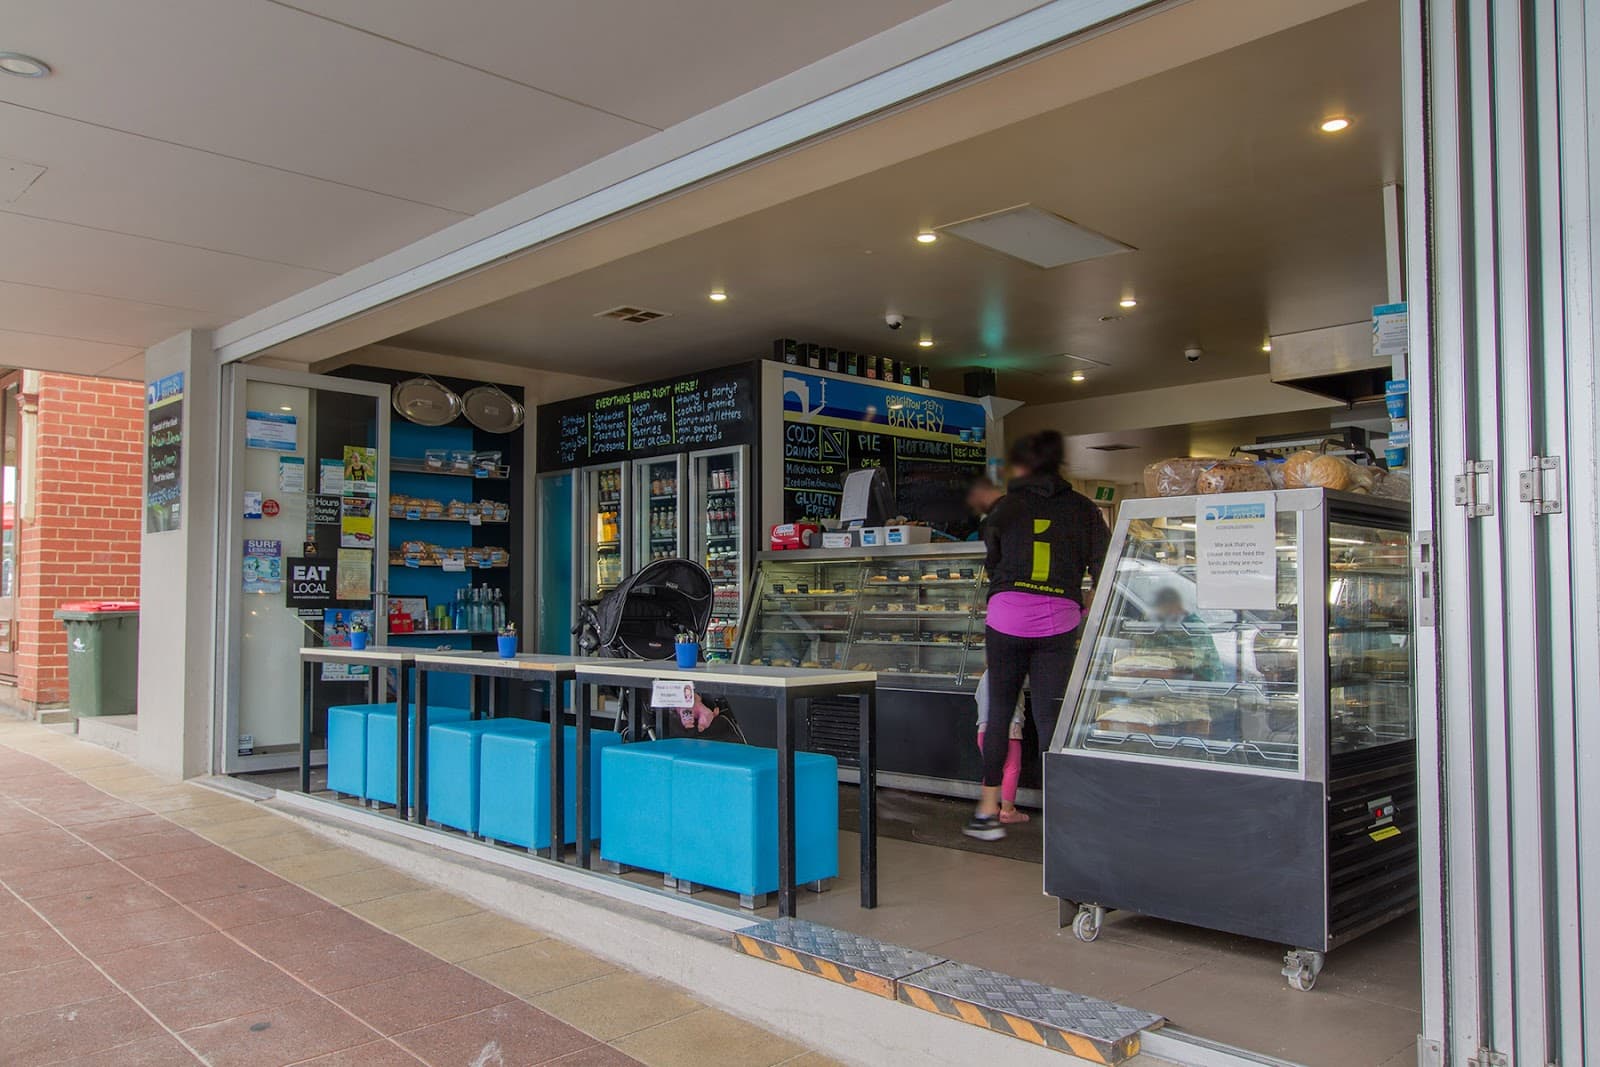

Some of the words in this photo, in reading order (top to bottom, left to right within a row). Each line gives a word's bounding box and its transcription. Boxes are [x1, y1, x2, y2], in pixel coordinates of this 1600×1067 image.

[595, 393, 631, 410] EVERYTHING
[633, 390, 651, 401] BAKED
[652, 385, 671, 398] RIGHT
[674, 378, 699, 394] HERE!
[676, 392, 701, 406] Having
[712, 382, 738, 399] party?
[887, 409, 945, 433] BAKERY
[786, 424, 816, 444] COLD
[632, 438, 646, 448] HOT
[858, 434, 881, 452] PIE
[897, 438, 918, 454] HOT
[785, 444, 819, 459] DRINKS
[316, 496, 340, 507] Hours
[795, 492, 837, 508] GLUTEN
[806, 504, 832, 516] FREE
[248, 540, 278, 548] SURF
[292, 566, 330, 581] EAT
[292, 582, 330, 594] LOCAL
